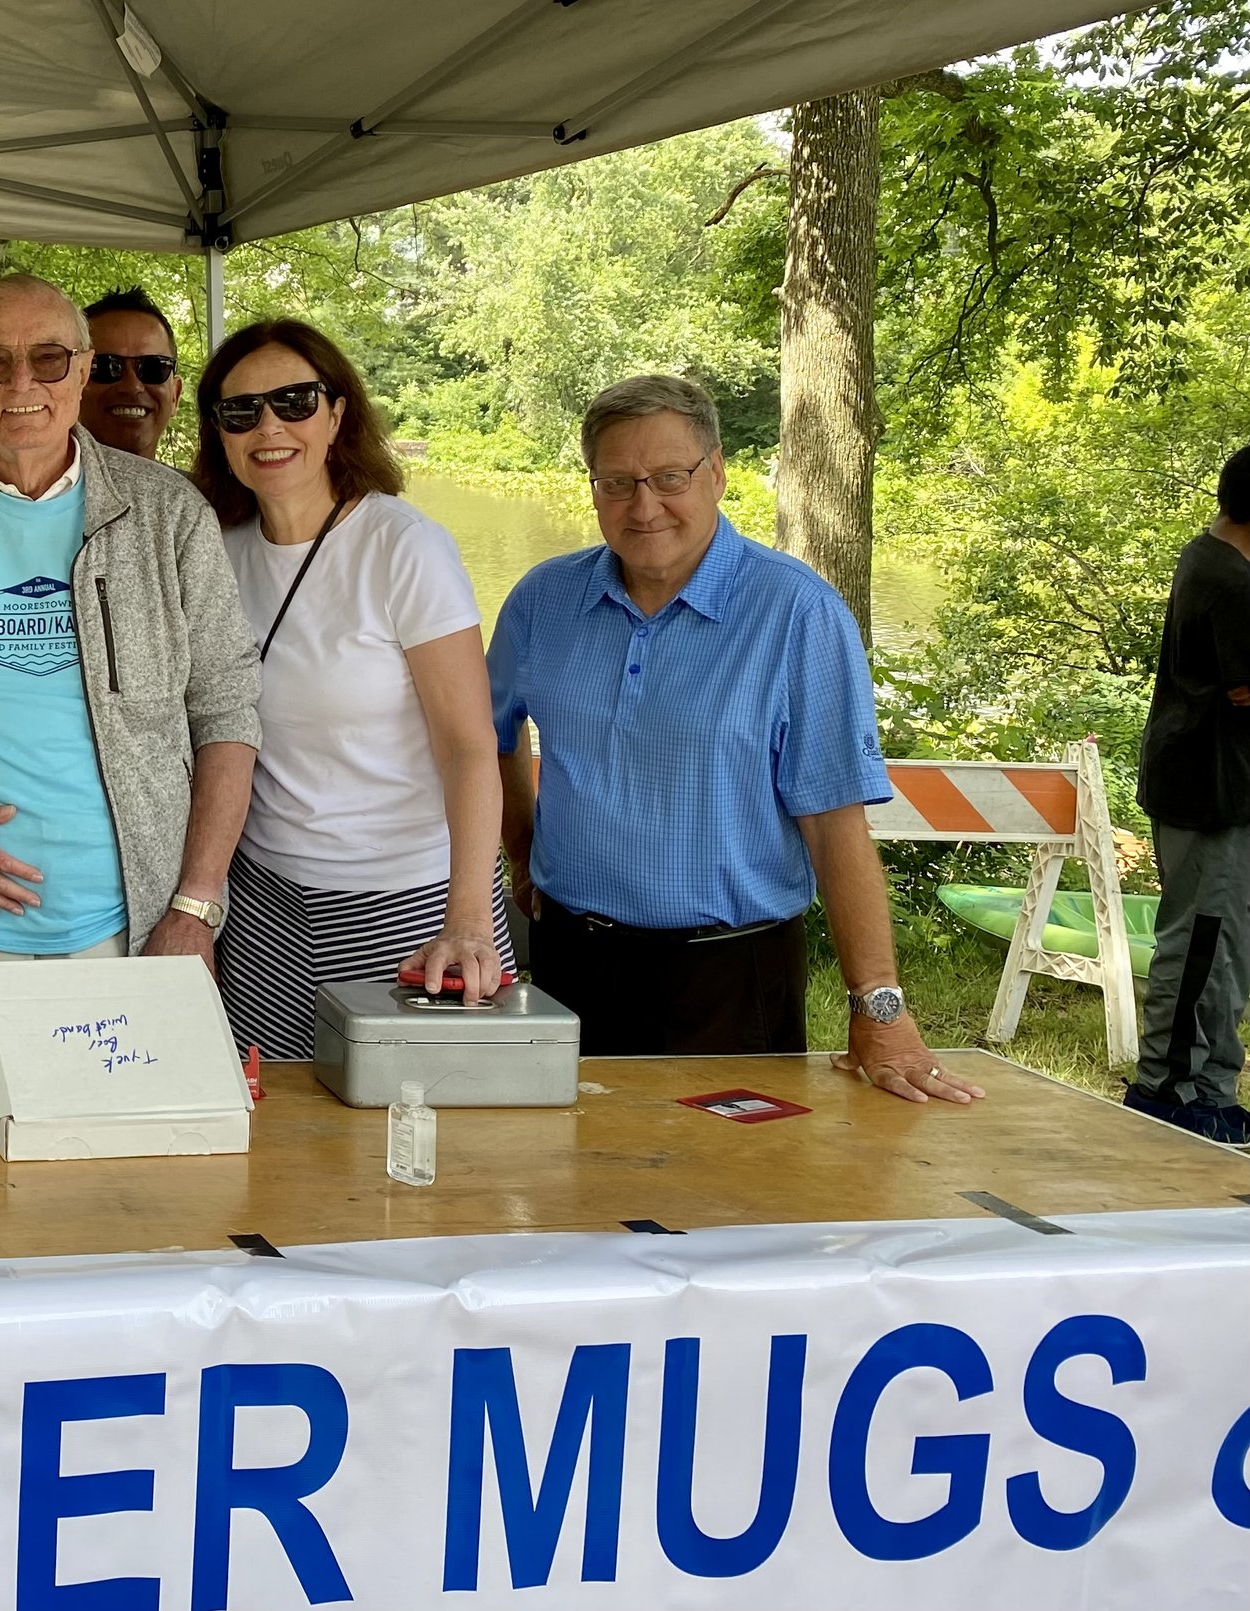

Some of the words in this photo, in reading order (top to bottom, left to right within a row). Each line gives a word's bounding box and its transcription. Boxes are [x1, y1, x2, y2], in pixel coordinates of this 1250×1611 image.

[21, 586, 33, 594] 3RD
[34, 583, 56, 593] ANNUAL
[8, 642, 46, 651] FAMILY
[48, 641, 77, 650] FESTI
[442, 1314, 1147, 1592] MUGS
